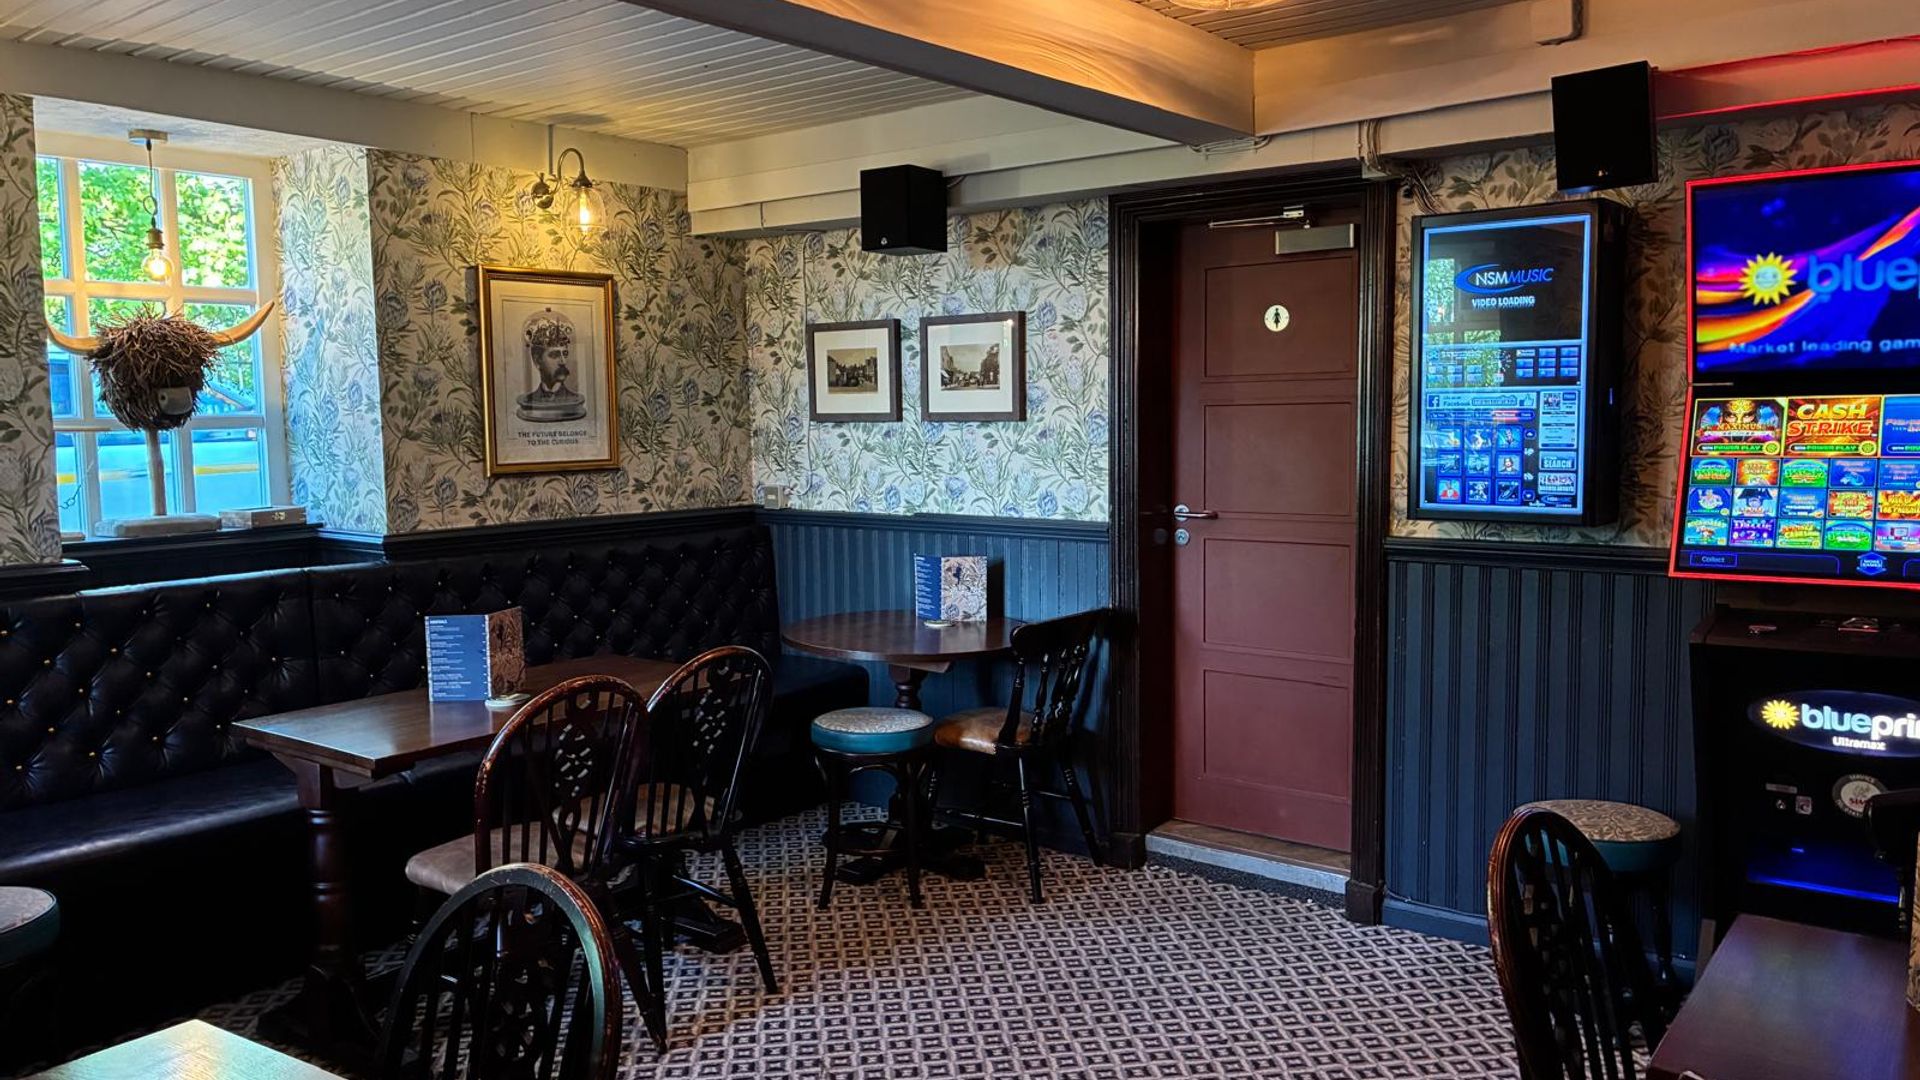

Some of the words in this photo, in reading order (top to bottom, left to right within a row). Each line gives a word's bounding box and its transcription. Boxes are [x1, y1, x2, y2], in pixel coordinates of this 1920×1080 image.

[1807, 253, 1920, 299] blue
[1472, 297, 1496, 307] VIDEO
[1498, 295, 1536, 307] LOADING
[1728, 342, 1795, 354] Market
[1802, 340, 1873, 353] leading
[1797, 403, 1868, 420] CASH
[1786, 420, 1874, 437] STRIKE
[551, 438, 579, 446] CURIOUS
[1543, 459, 1573, 468] SEARCH
[1801, 703, 1920, 740] bluepri
[1832, 736, 1886, 751] Ultramax
